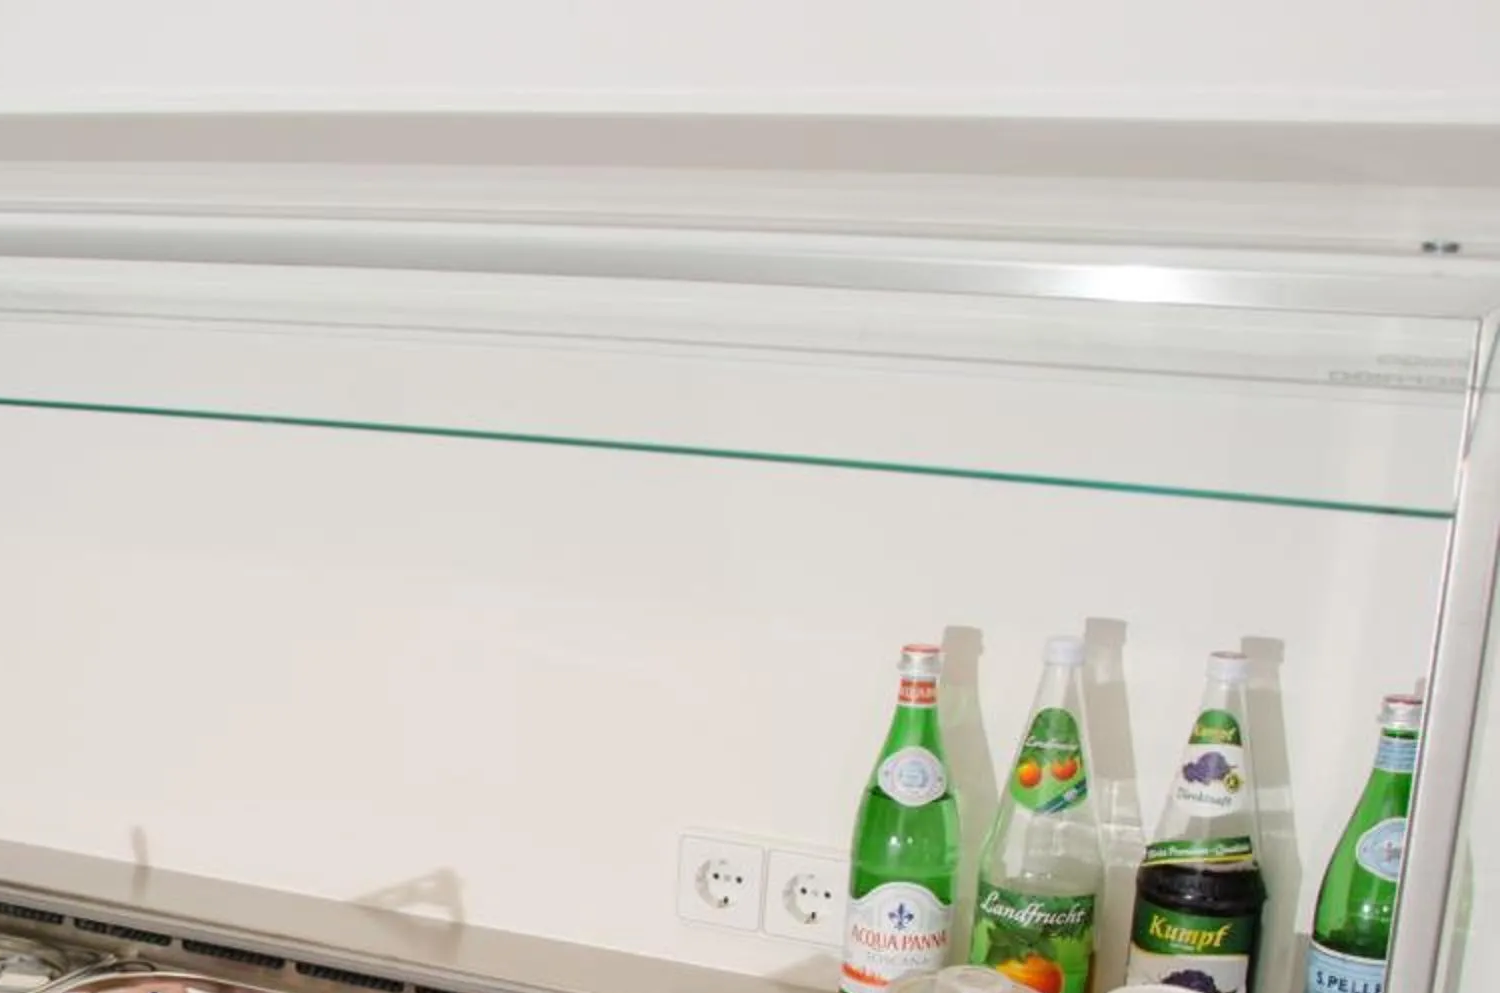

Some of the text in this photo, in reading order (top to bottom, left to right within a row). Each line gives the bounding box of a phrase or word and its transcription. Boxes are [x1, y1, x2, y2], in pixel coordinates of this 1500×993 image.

[979, 890, 1086, 928] Landfrucht
[851, 923, 949, 951] ACQUA PANNA
[1149, 913, 1234, 951] Kumpf
